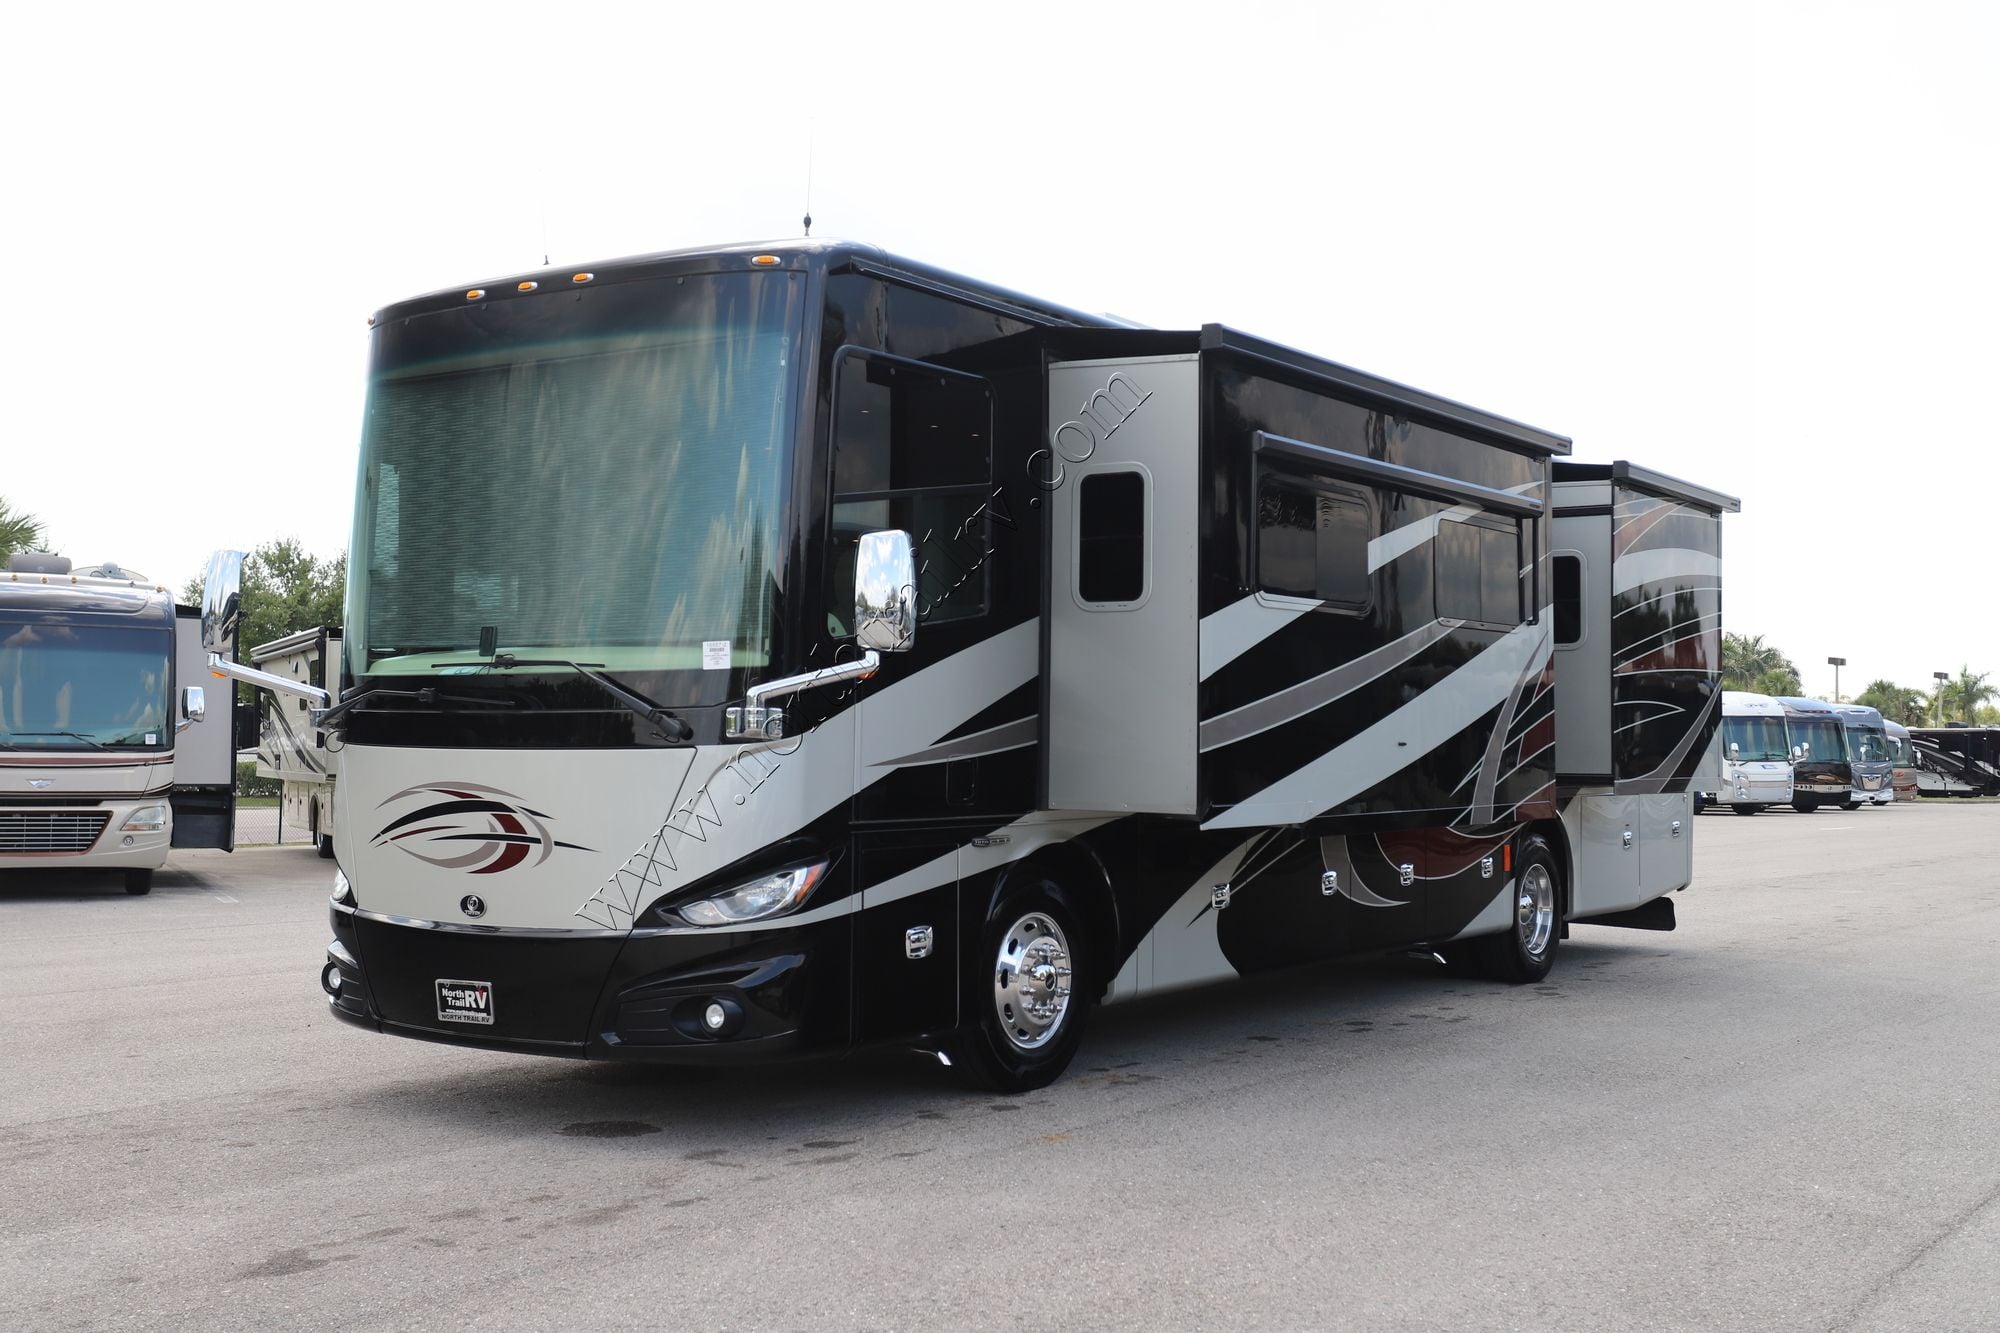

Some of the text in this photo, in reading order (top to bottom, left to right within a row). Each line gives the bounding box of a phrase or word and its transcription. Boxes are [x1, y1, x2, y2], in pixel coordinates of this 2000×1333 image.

[441, 988, 465, 998] North
[446, 997, 465, 1007] Trail
[464, 990, 487, 1009] RV
